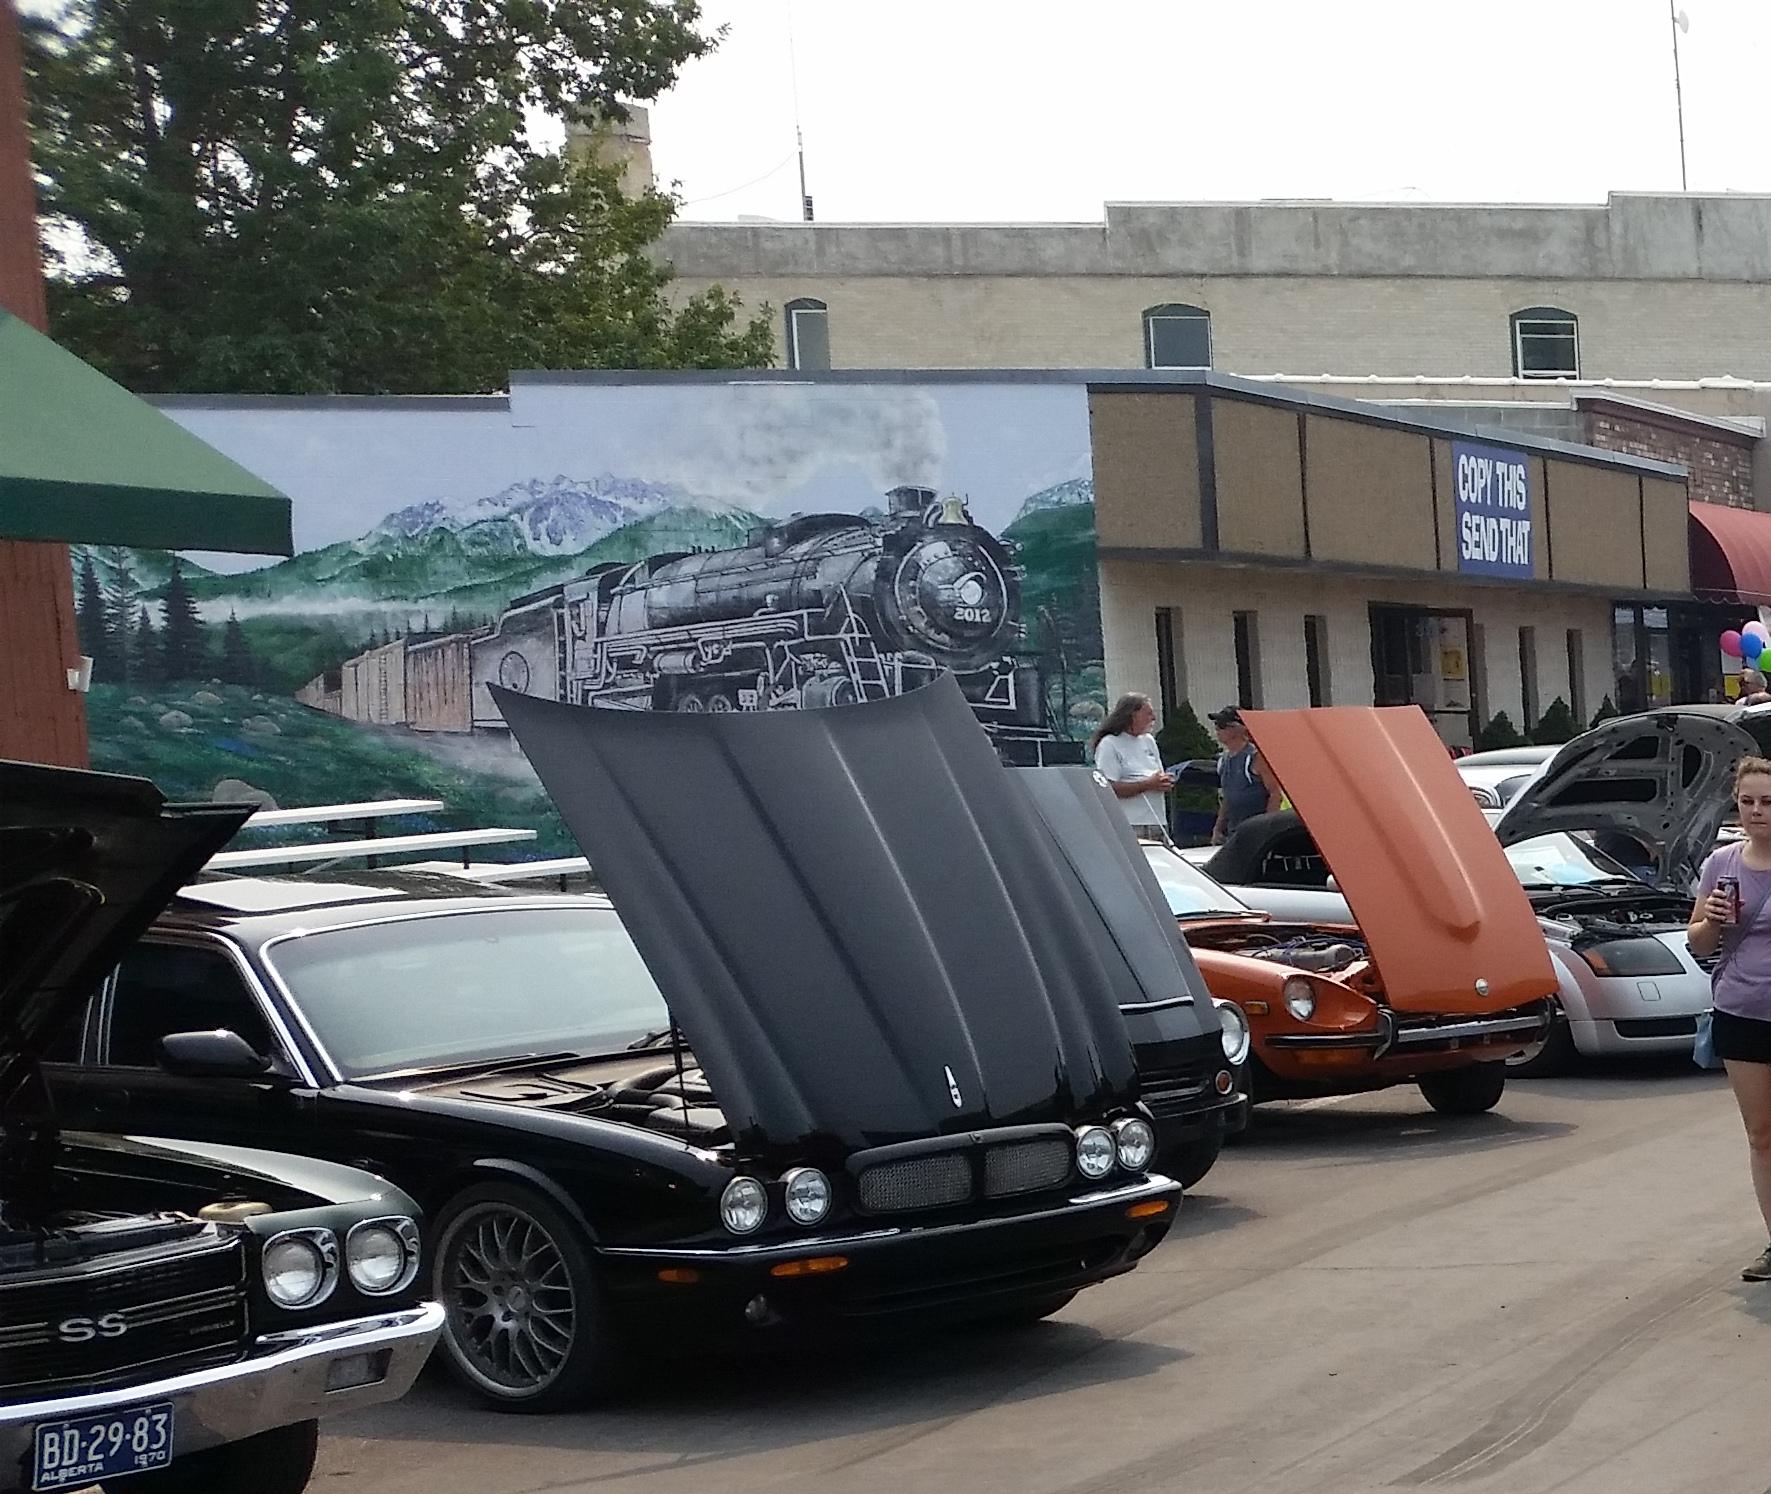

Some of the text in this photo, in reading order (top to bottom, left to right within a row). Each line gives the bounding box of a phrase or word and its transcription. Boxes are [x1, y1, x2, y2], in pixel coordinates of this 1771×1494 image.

[1458, 453, 1527, 511] COPY THIS
[1461, 511, 1531, 566] SEND THAT
[953, 606, 992, 623] 2012
[58, 1313, 128, 1342] SS
[134, 1450, 167, 1468] 1970
[40, 1462, 105, 1484] ALBERTA
